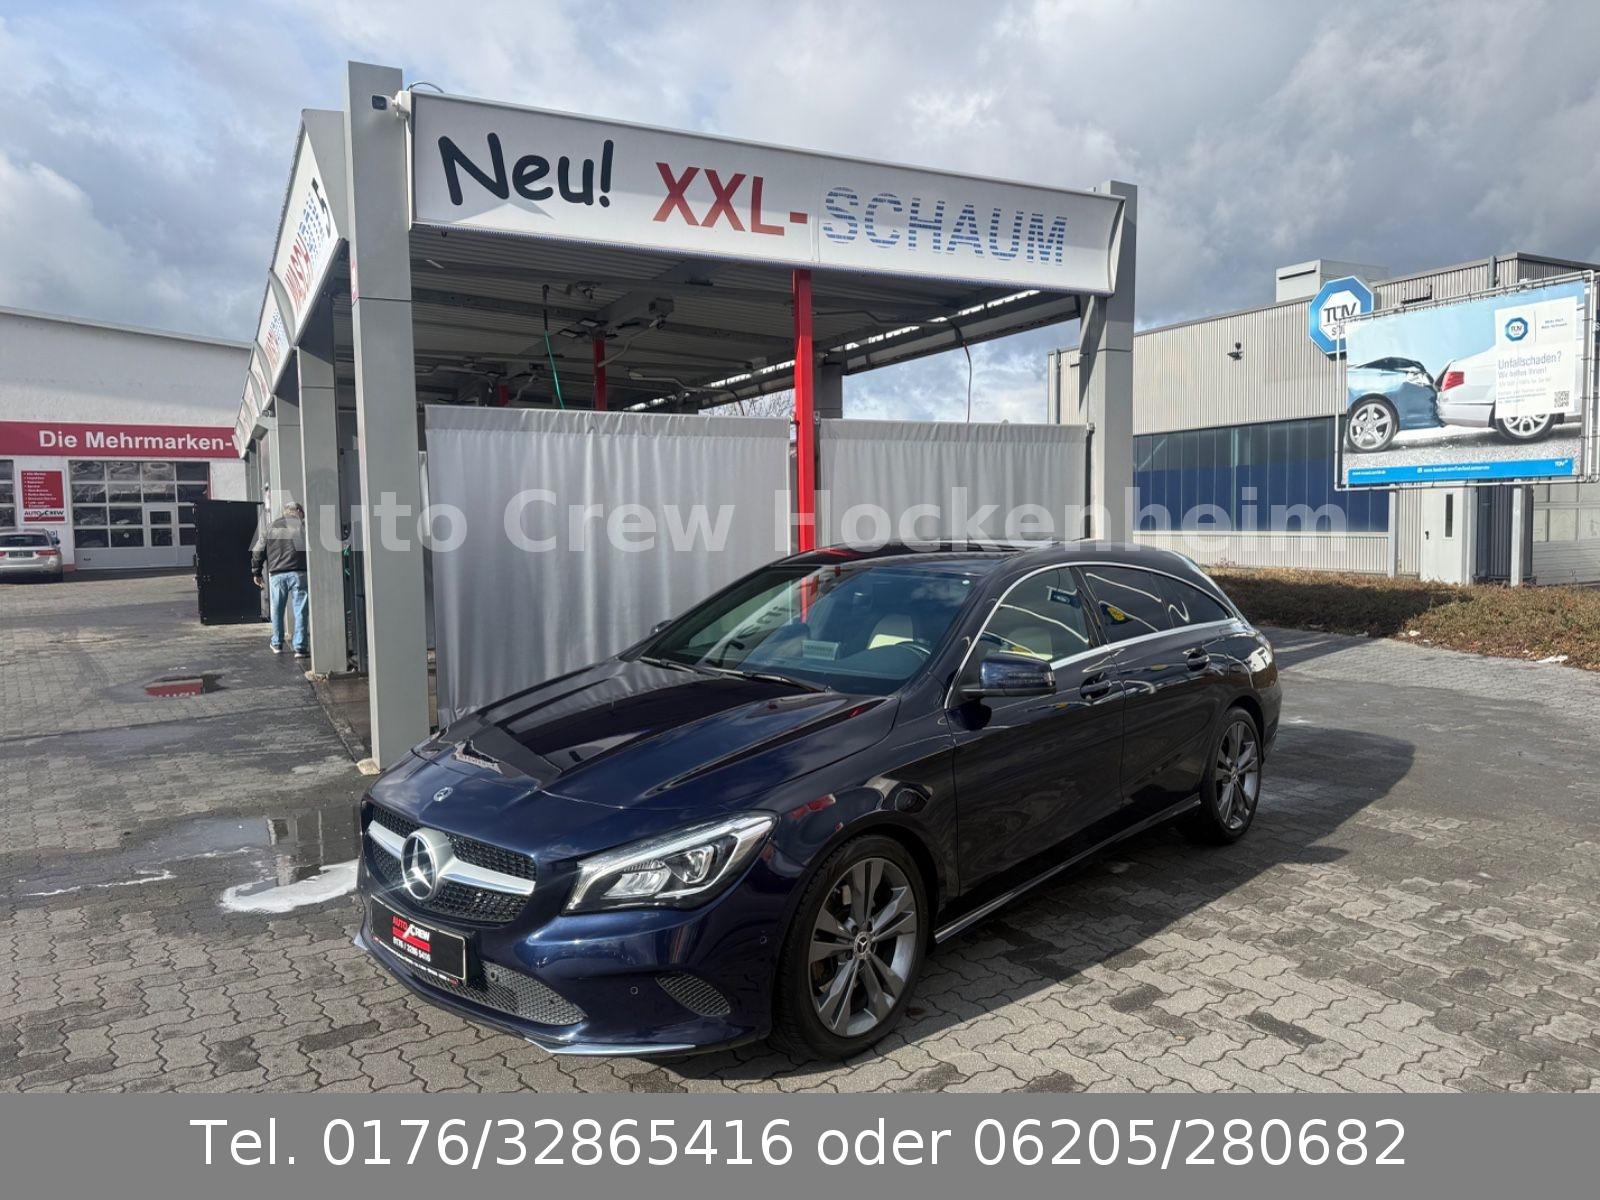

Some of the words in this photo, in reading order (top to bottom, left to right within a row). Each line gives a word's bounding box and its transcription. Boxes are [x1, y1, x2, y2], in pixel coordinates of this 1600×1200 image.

[437, 132, 614, 208] Neu!
[1324, 303, 1356, 322] TÜV
[1498, 350, 1562, 370] Unfallschaden?
[38, 430, 78, 448] Die
